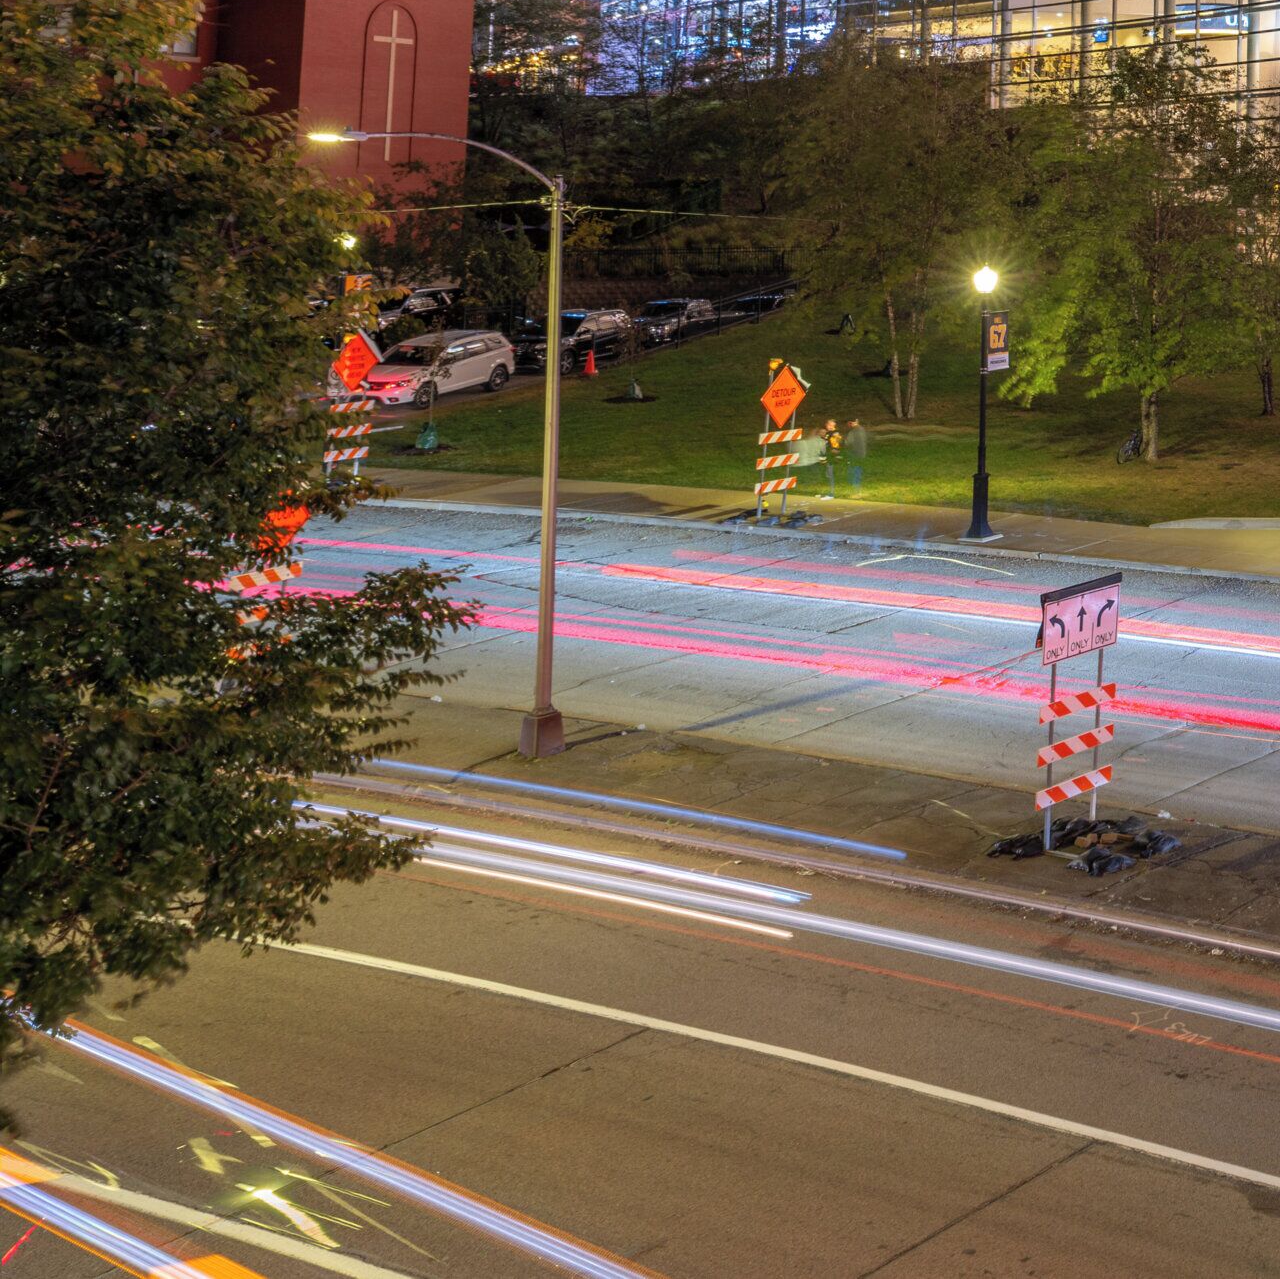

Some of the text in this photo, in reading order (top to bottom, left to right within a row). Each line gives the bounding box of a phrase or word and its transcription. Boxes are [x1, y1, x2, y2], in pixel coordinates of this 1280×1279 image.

[990, 324, 1007, 349] 67
[771, 387, 796, 398] DETOUR
[1046, 630, 1114, 660] ONLY ONLY ONLY
